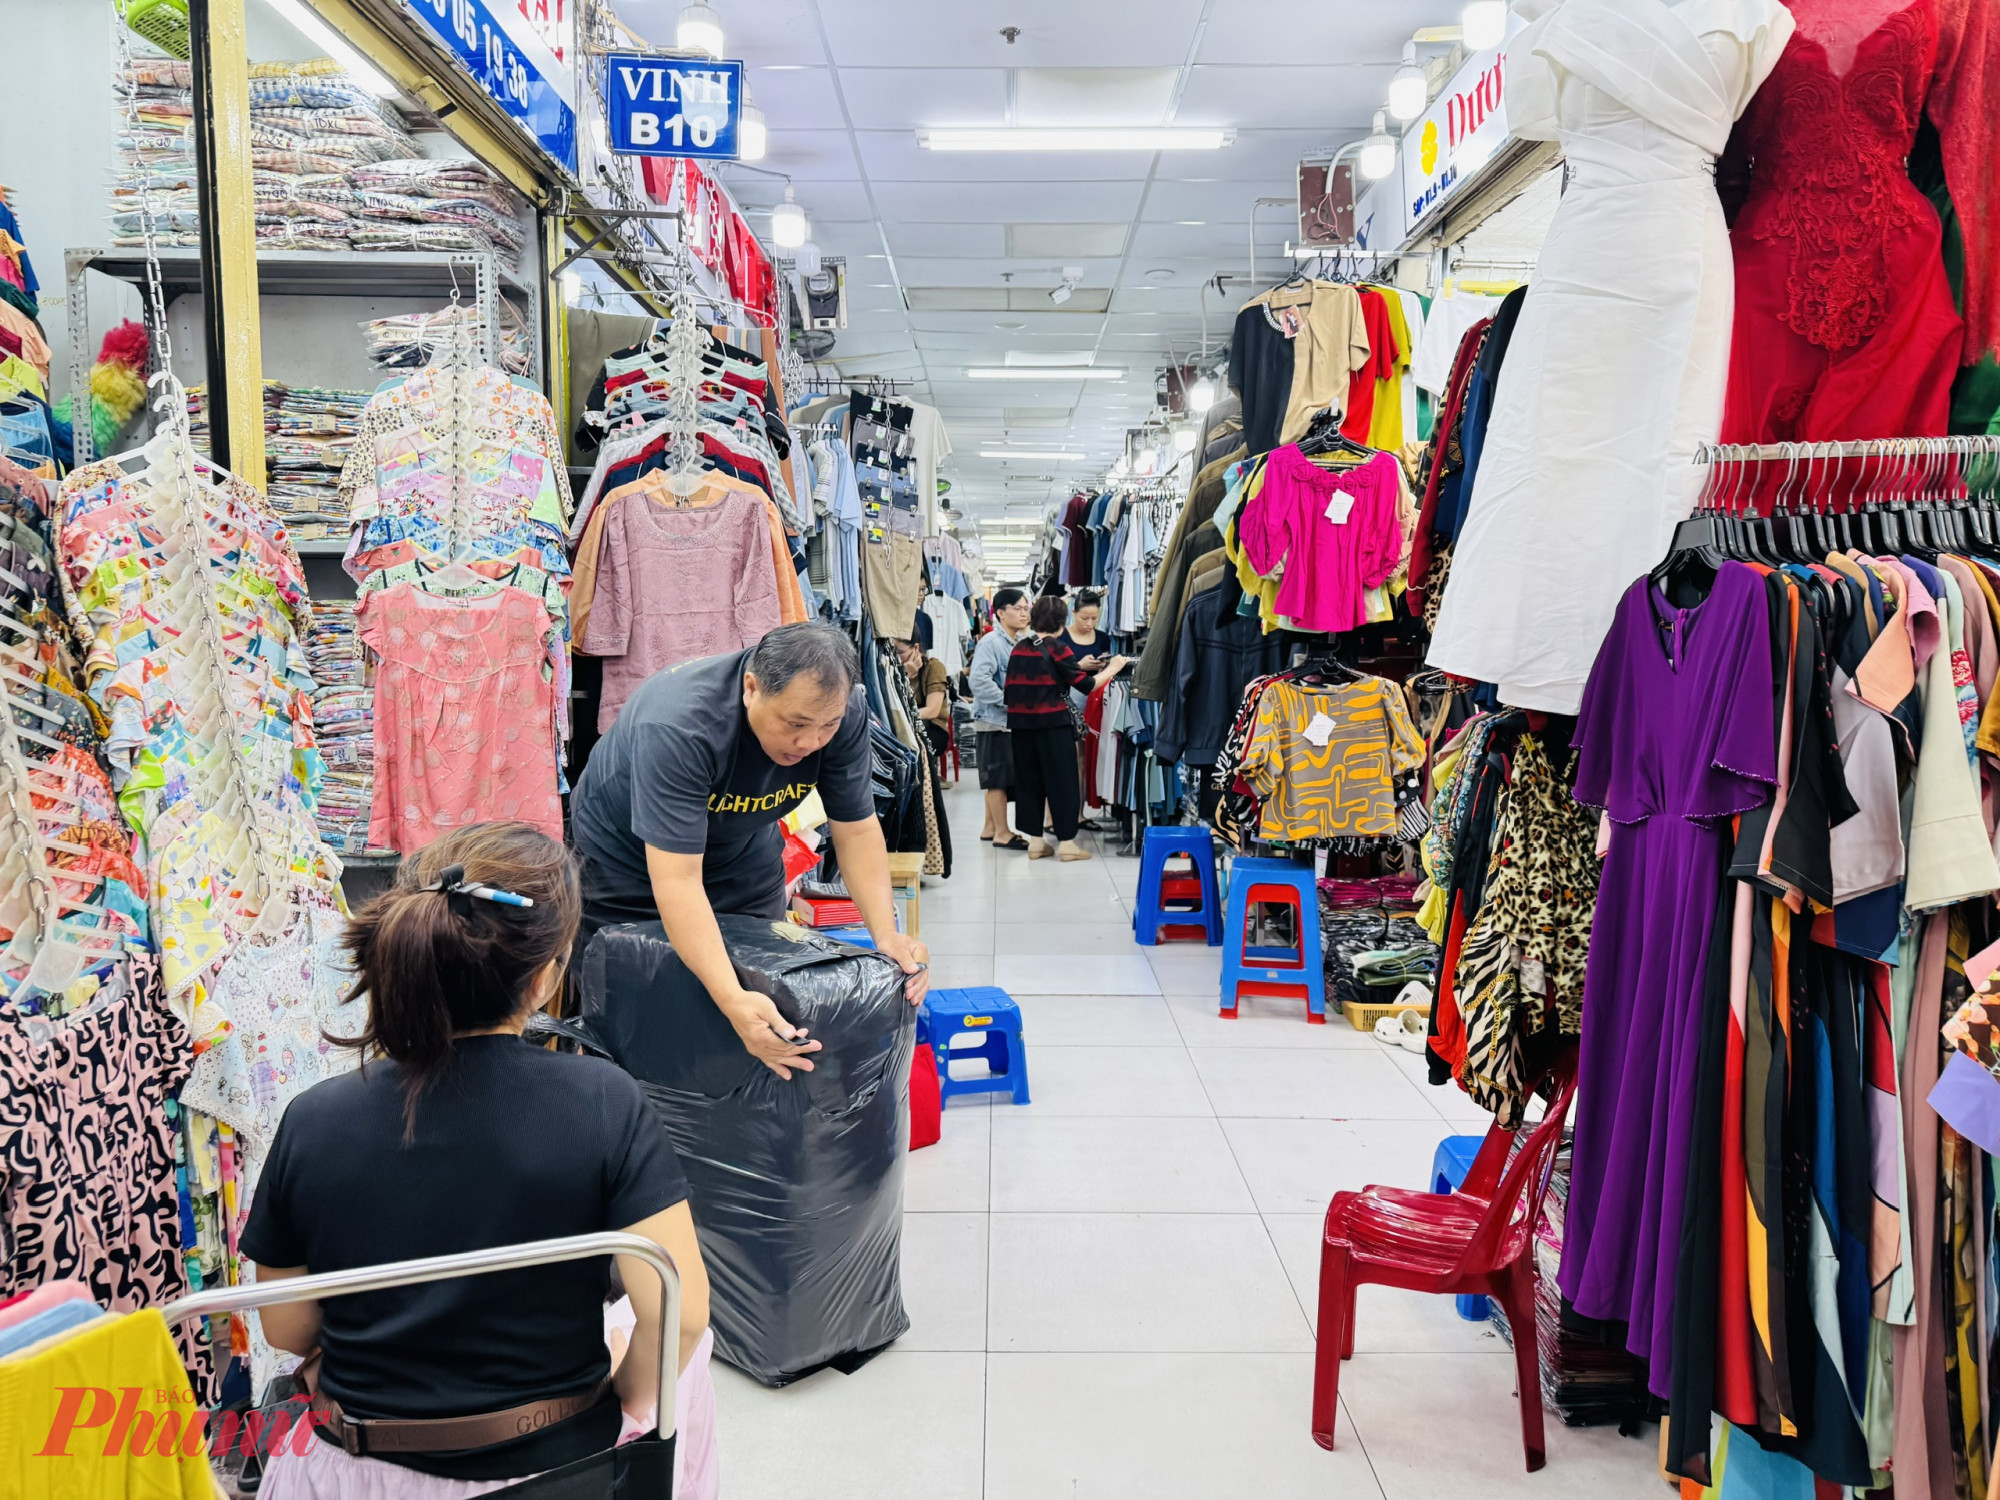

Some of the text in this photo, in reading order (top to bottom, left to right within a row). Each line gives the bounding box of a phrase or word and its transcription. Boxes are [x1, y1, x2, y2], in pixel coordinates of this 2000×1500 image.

[452, 0, 528, 109] 05 19 38
[617, 66, 732, 104] VINH
[630, 112, 717, 147] B10
